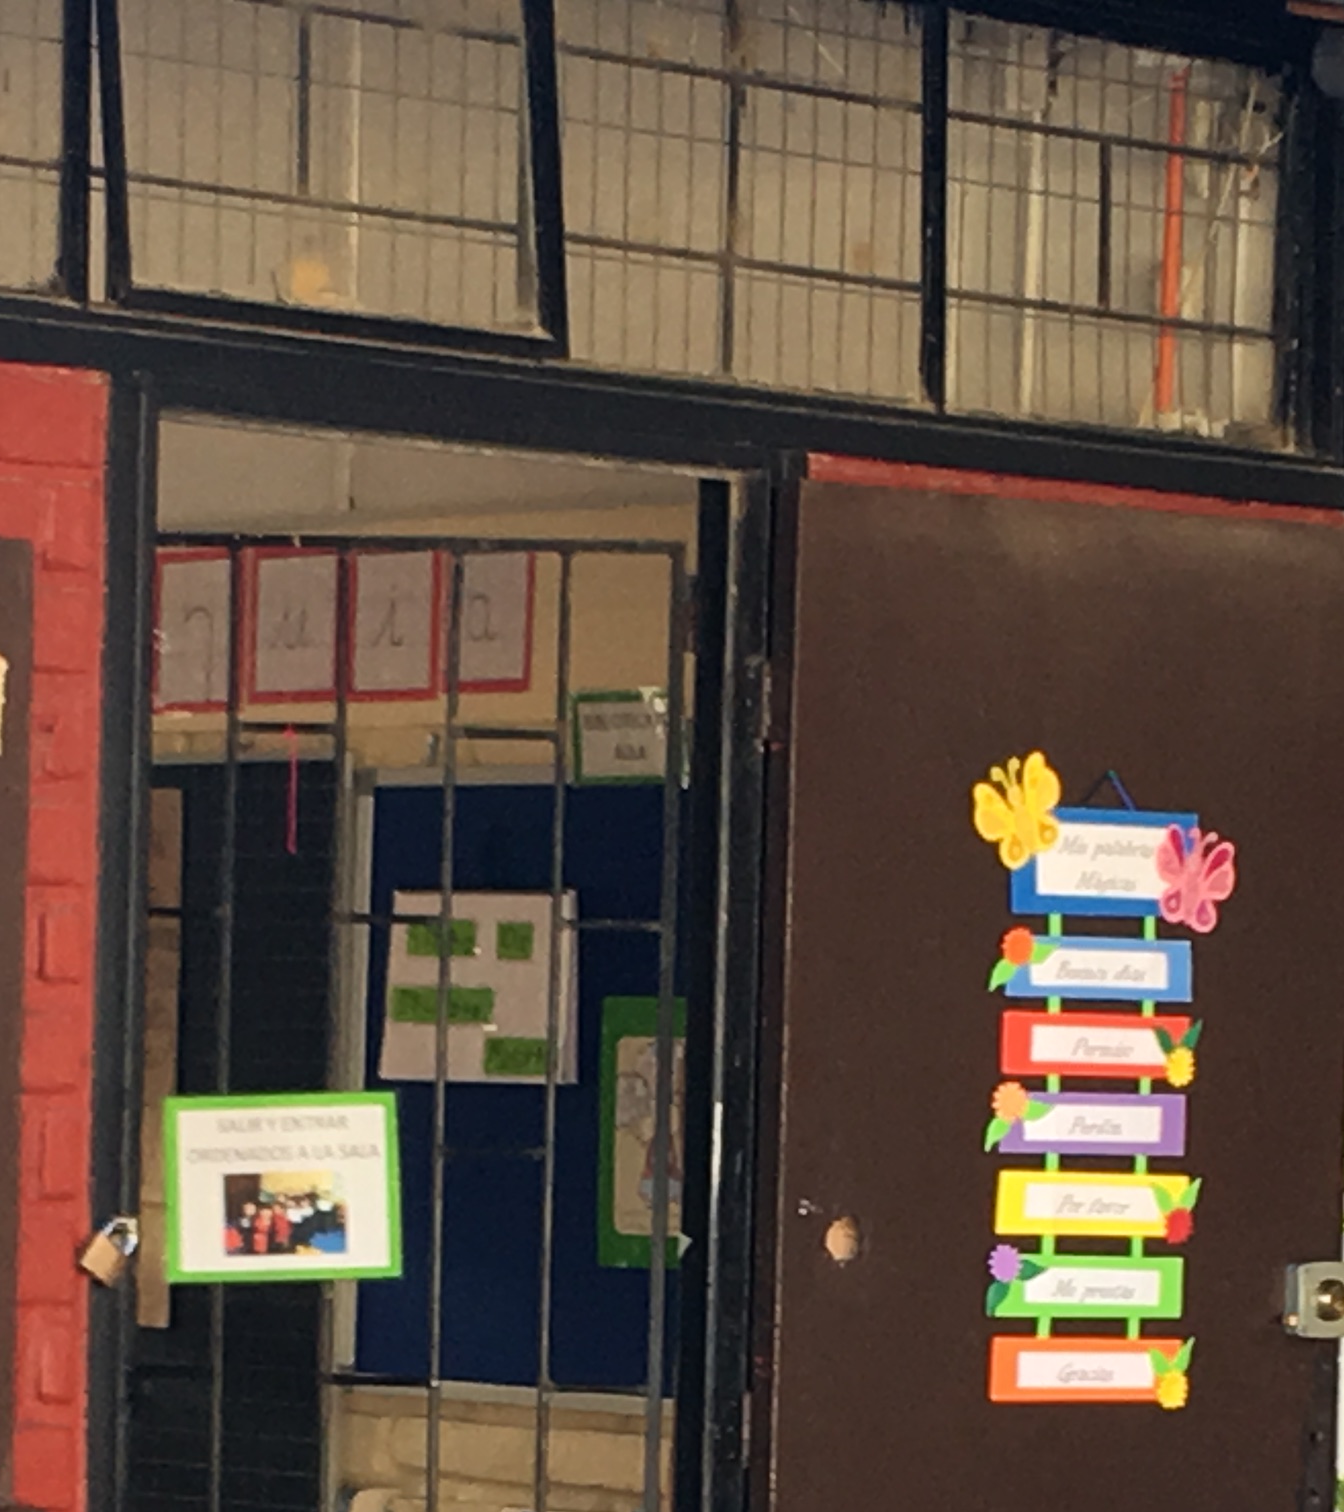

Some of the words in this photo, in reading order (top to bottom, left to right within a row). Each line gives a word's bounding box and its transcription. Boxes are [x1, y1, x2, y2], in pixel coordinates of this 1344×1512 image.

[216, 1117, 262, 1134] SALIR
[281, 1115, 350, 1133] ENTRAR
[298, 1145, 310, 1161] A
[312, 1145, 334, 1161] LA
[338, 1143, 381, 1161] SALA
